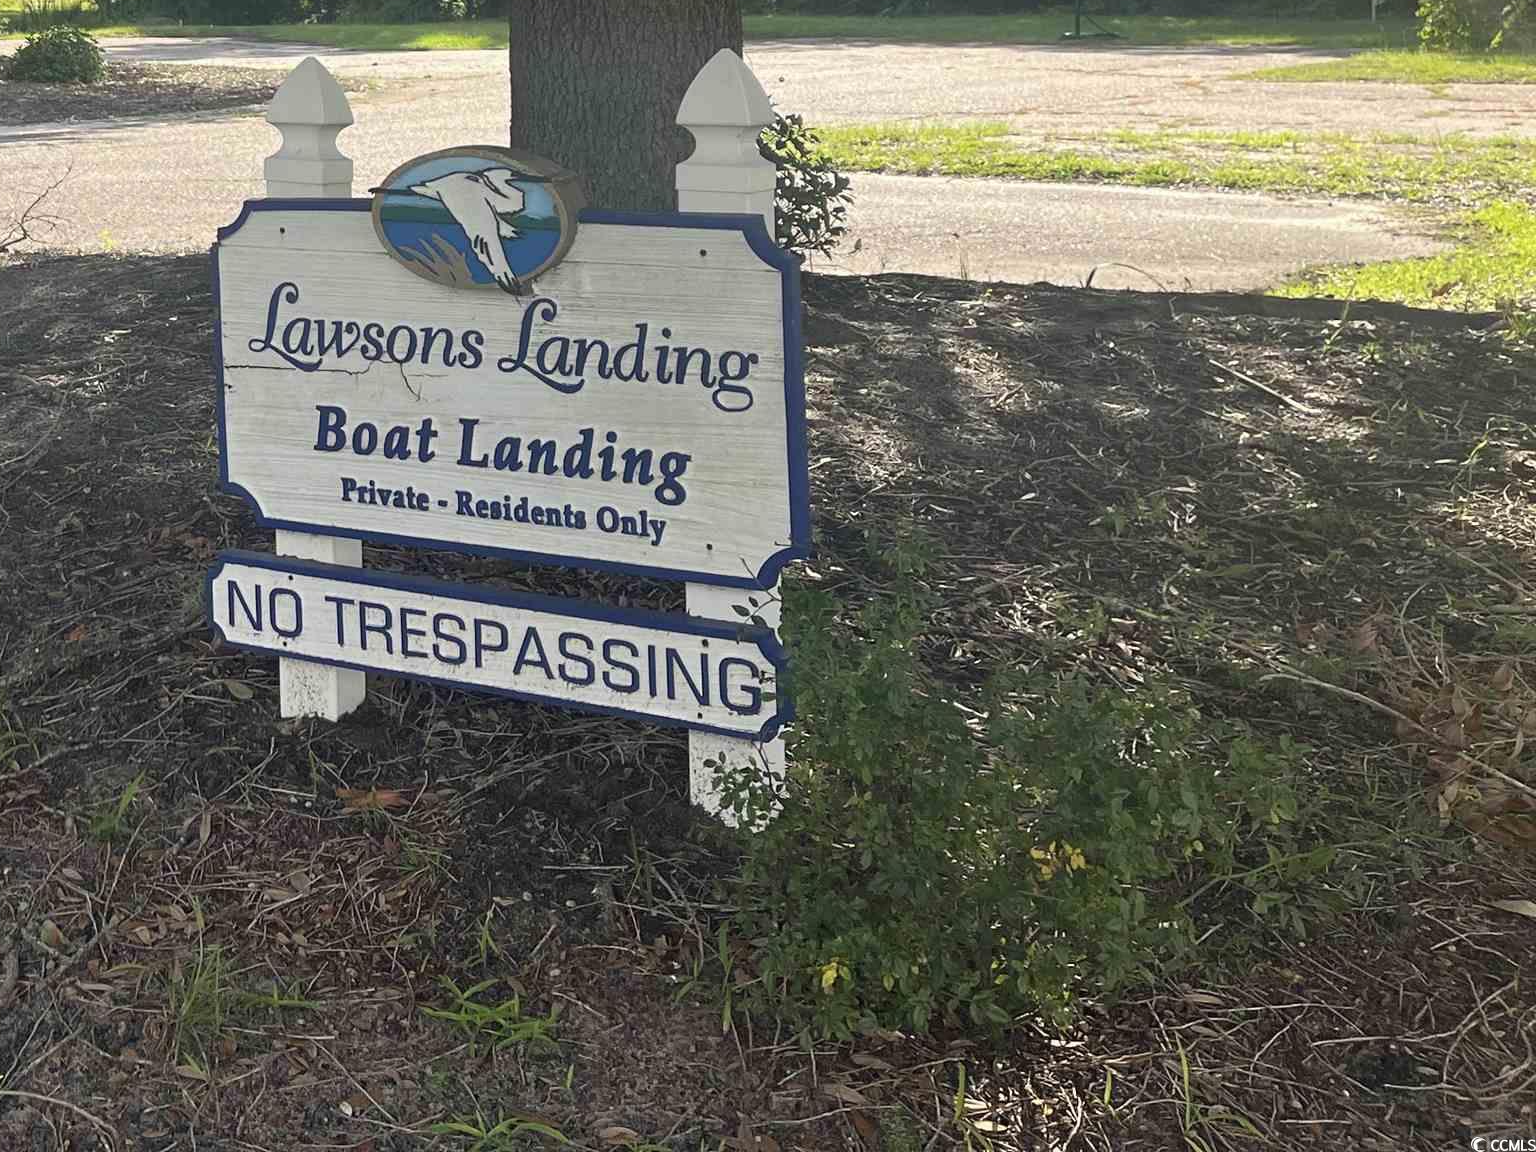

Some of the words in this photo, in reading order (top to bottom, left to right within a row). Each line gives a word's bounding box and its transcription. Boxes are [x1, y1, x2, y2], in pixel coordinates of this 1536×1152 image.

[248, 282, 483, 372] Lawsons
[498, 299, 759, 411] Landing
[314, 405, 439, 463] Boat
[457, 418, 691, 505] Landing
[341, 478, 430, 512] Private
[455, 490, 586, 529] Residents
[596, 507, 667, 544] Only
[226, 580, 304, 639] NO
[325, 595, 762, 715] TRESPASSING
